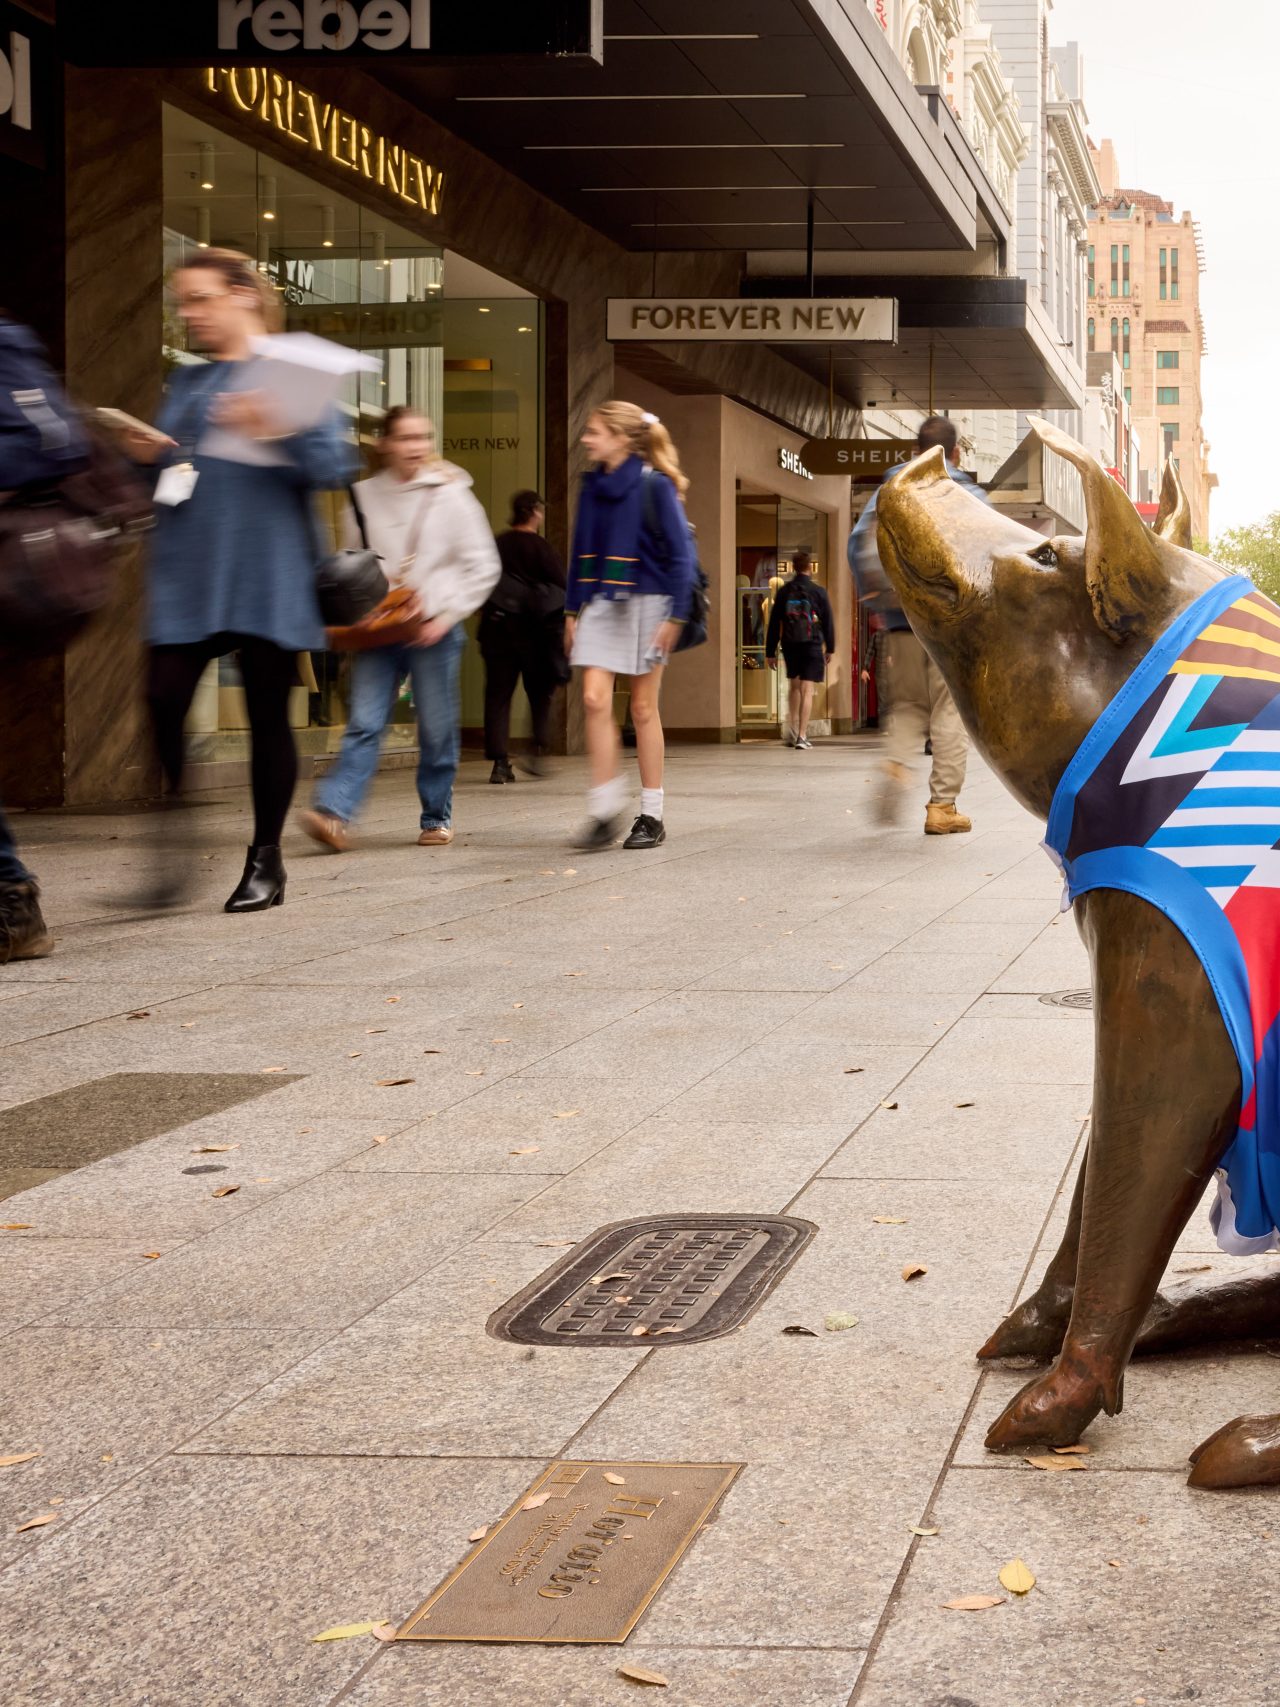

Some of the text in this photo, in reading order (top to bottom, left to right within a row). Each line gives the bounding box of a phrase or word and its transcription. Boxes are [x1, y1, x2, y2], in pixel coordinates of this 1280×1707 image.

[377, 136, 447, 215] NEW
[631, 305, 865, 330] FOREVER NEW
[485, 437, 520, 450] NEW
[537, 1491, 665, 1599] Horatio
